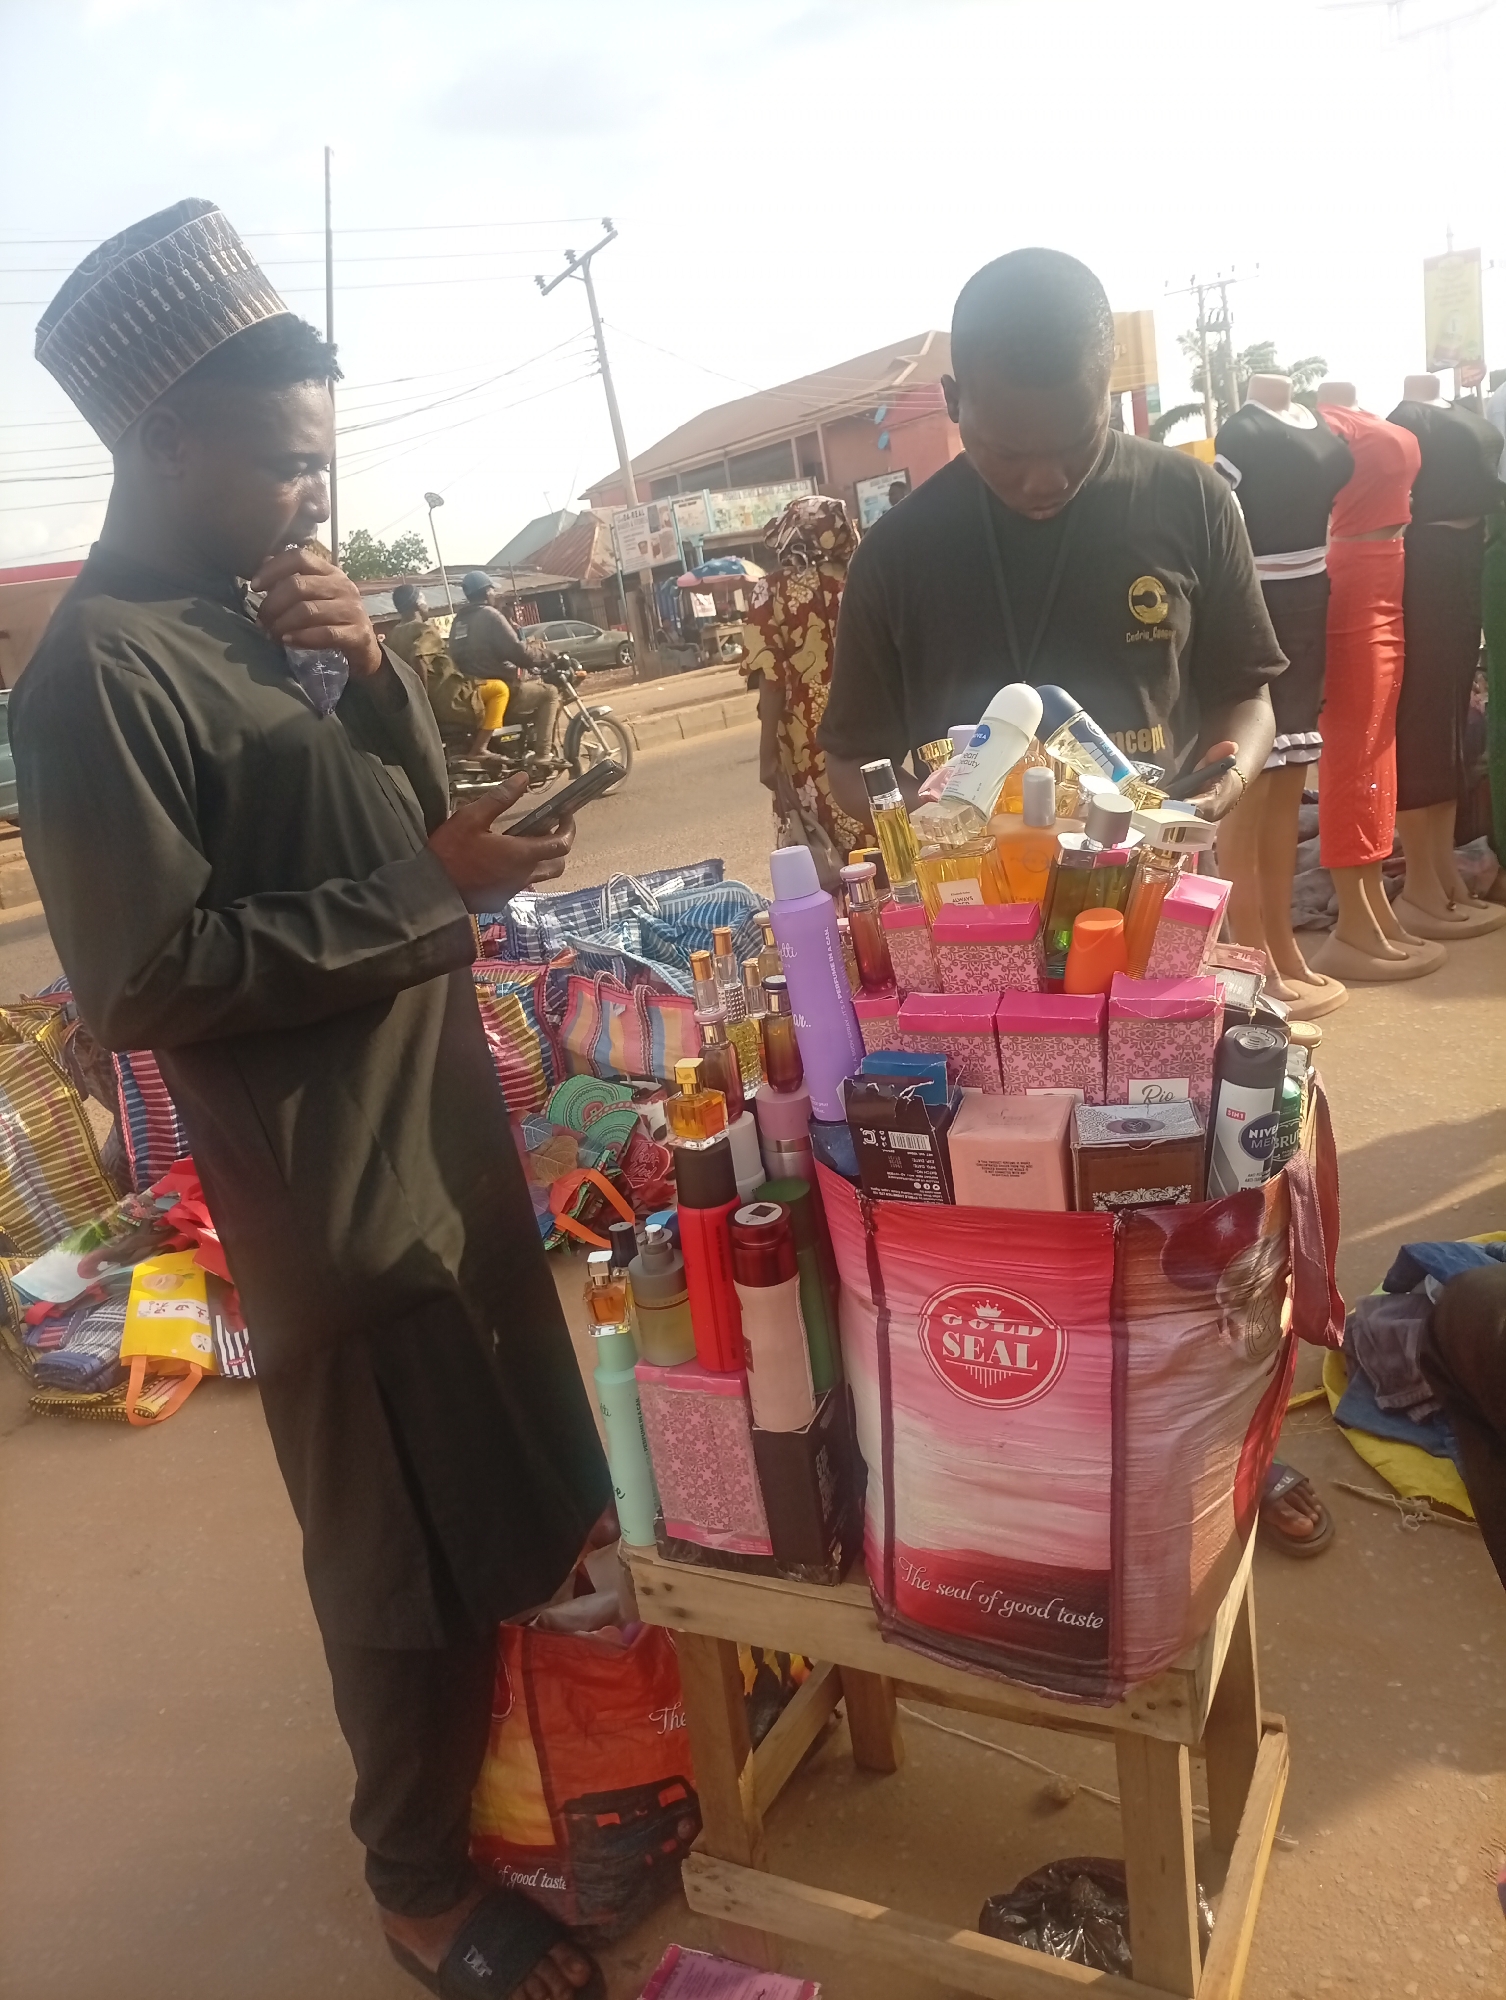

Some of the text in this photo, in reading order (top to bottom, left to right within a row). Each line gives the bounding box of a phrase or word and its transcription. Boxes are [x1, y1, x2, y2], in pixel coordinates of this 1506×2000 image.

[1109, 724, 1166, 754] ncept
[1142, 1084, 1175, 1104] Rio
[942, 1331, 1038, 1371] SEAL
[898, 1556, 1104, 1629] The seal of good taste
[507, 1867, 545, 1889] good
